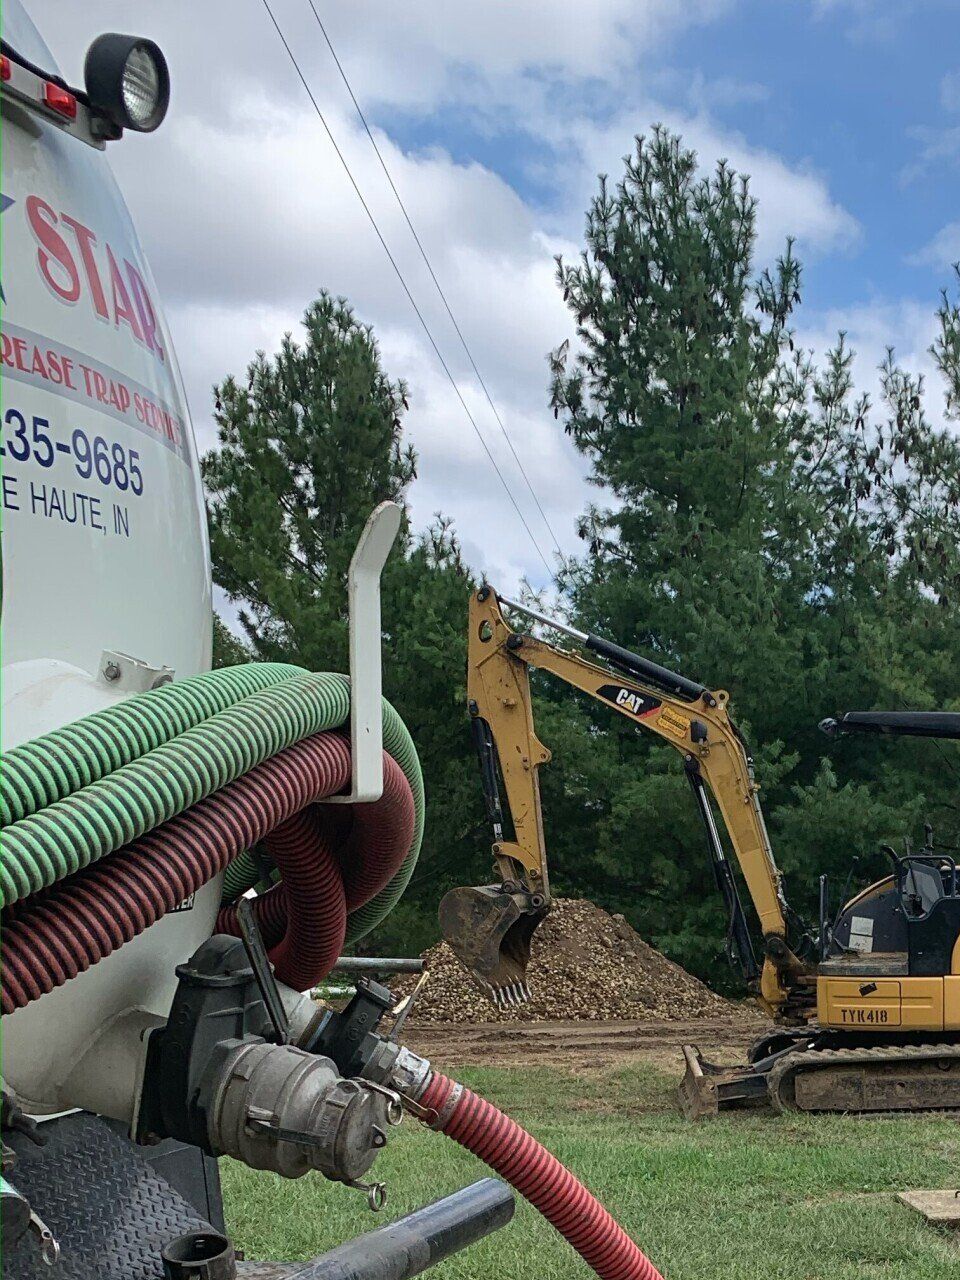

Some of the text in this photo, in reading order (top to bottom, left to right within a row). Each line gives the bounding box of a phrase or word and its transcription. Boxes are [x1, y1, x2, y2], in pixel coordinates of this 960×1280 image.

[25, 194, 165, 363] STAR
[79, 363, 130, 413] TRAP
[0, 408, 143, 497] 35-9685
[30, 482, 107, 536] HAUTE,
[113, 503, 129, 537] IN
[616, 688, 645, 714] CAT
